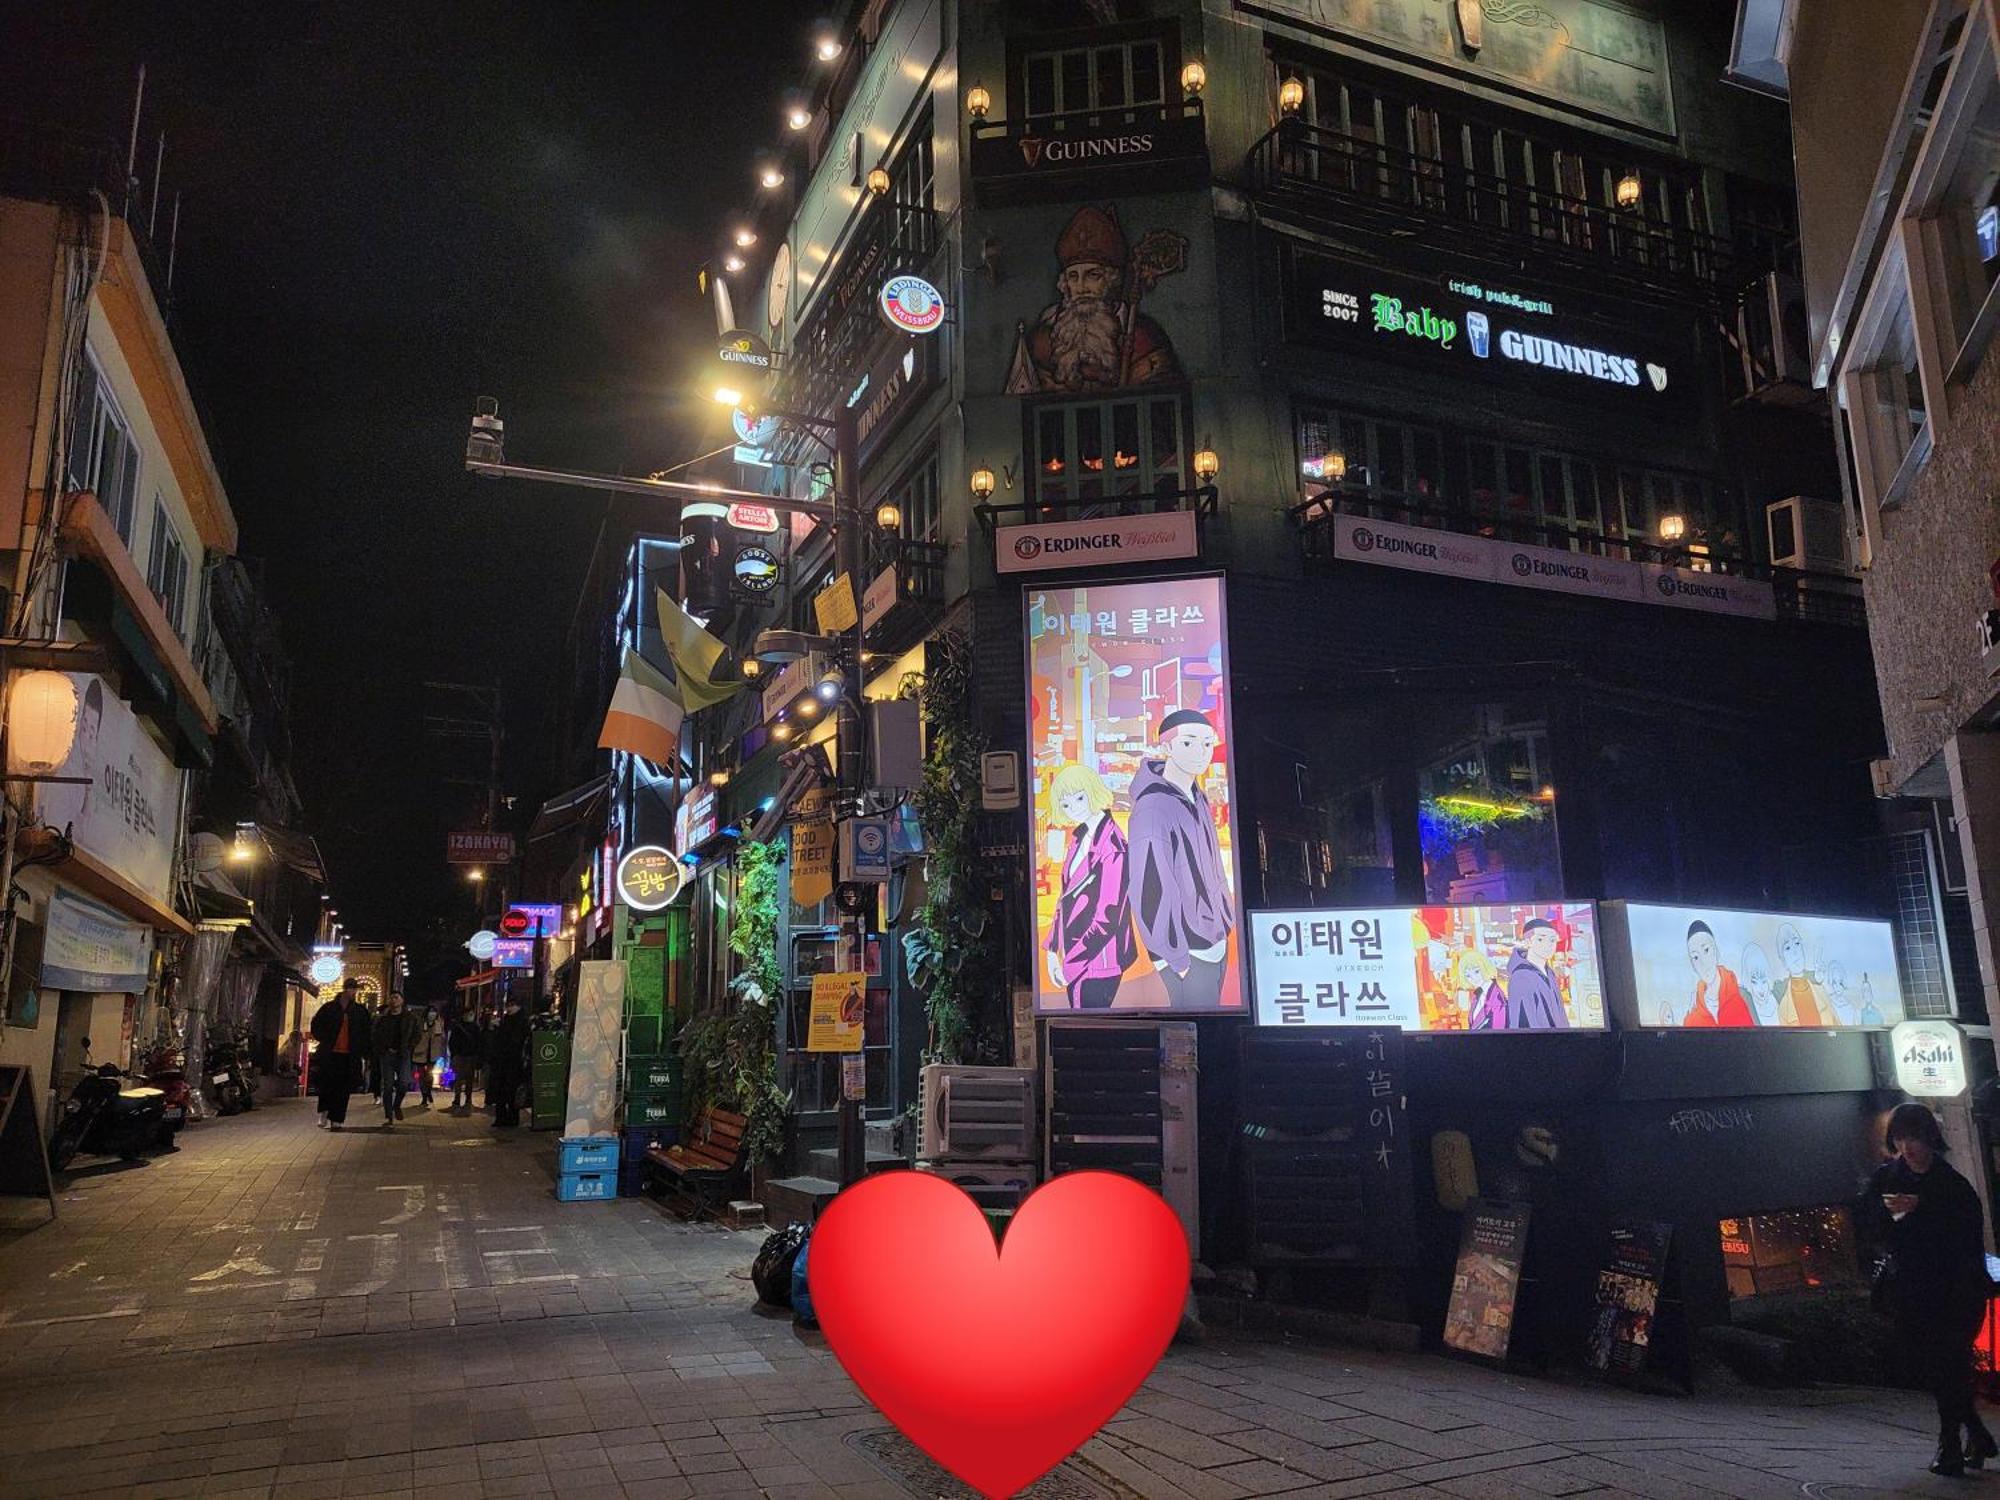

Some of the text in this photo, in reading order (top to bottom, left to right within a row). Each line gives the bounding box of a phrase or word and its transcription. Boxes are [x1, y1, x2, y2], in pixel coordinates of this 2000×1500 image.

[1046, 134, 1153, 161] GUINNESS
[889, 279, 942, 304] ERDINGER
[1322, 289, 1359, 308] SINCE
[1323, 304, 1358, 323] 2007
[1370, 292, 1640, 386] Baby GUINNESS
[719, 350, 769, 367] GUINNESS
[1043, 534, 1123, 554] ERDINGER
[1375, 534, 1439, 560] ERDINGER
[1533, 559, 1591, 583] ERDINGER
[1677, 581, 1729, 600] ERDINGER
[1044, 606, 1205, 636] 이태원 클라쓰
[450, 834, 509, 849] IZAKAYA
[793, 848, 826, 862] TREET
[1271, 918, 1384, 961] 이태원
[1274, 981, 1390, 1024] 클라쓰
[1388, 1013, 1408, 1021] Class
[1903, 1045, 1954, 1063] Asahi
[649, 1072, 670, 1084] TERRA
[1923, 1067, 1937, 1077] 生
[645, 1106, 668, 1118] TERRA
